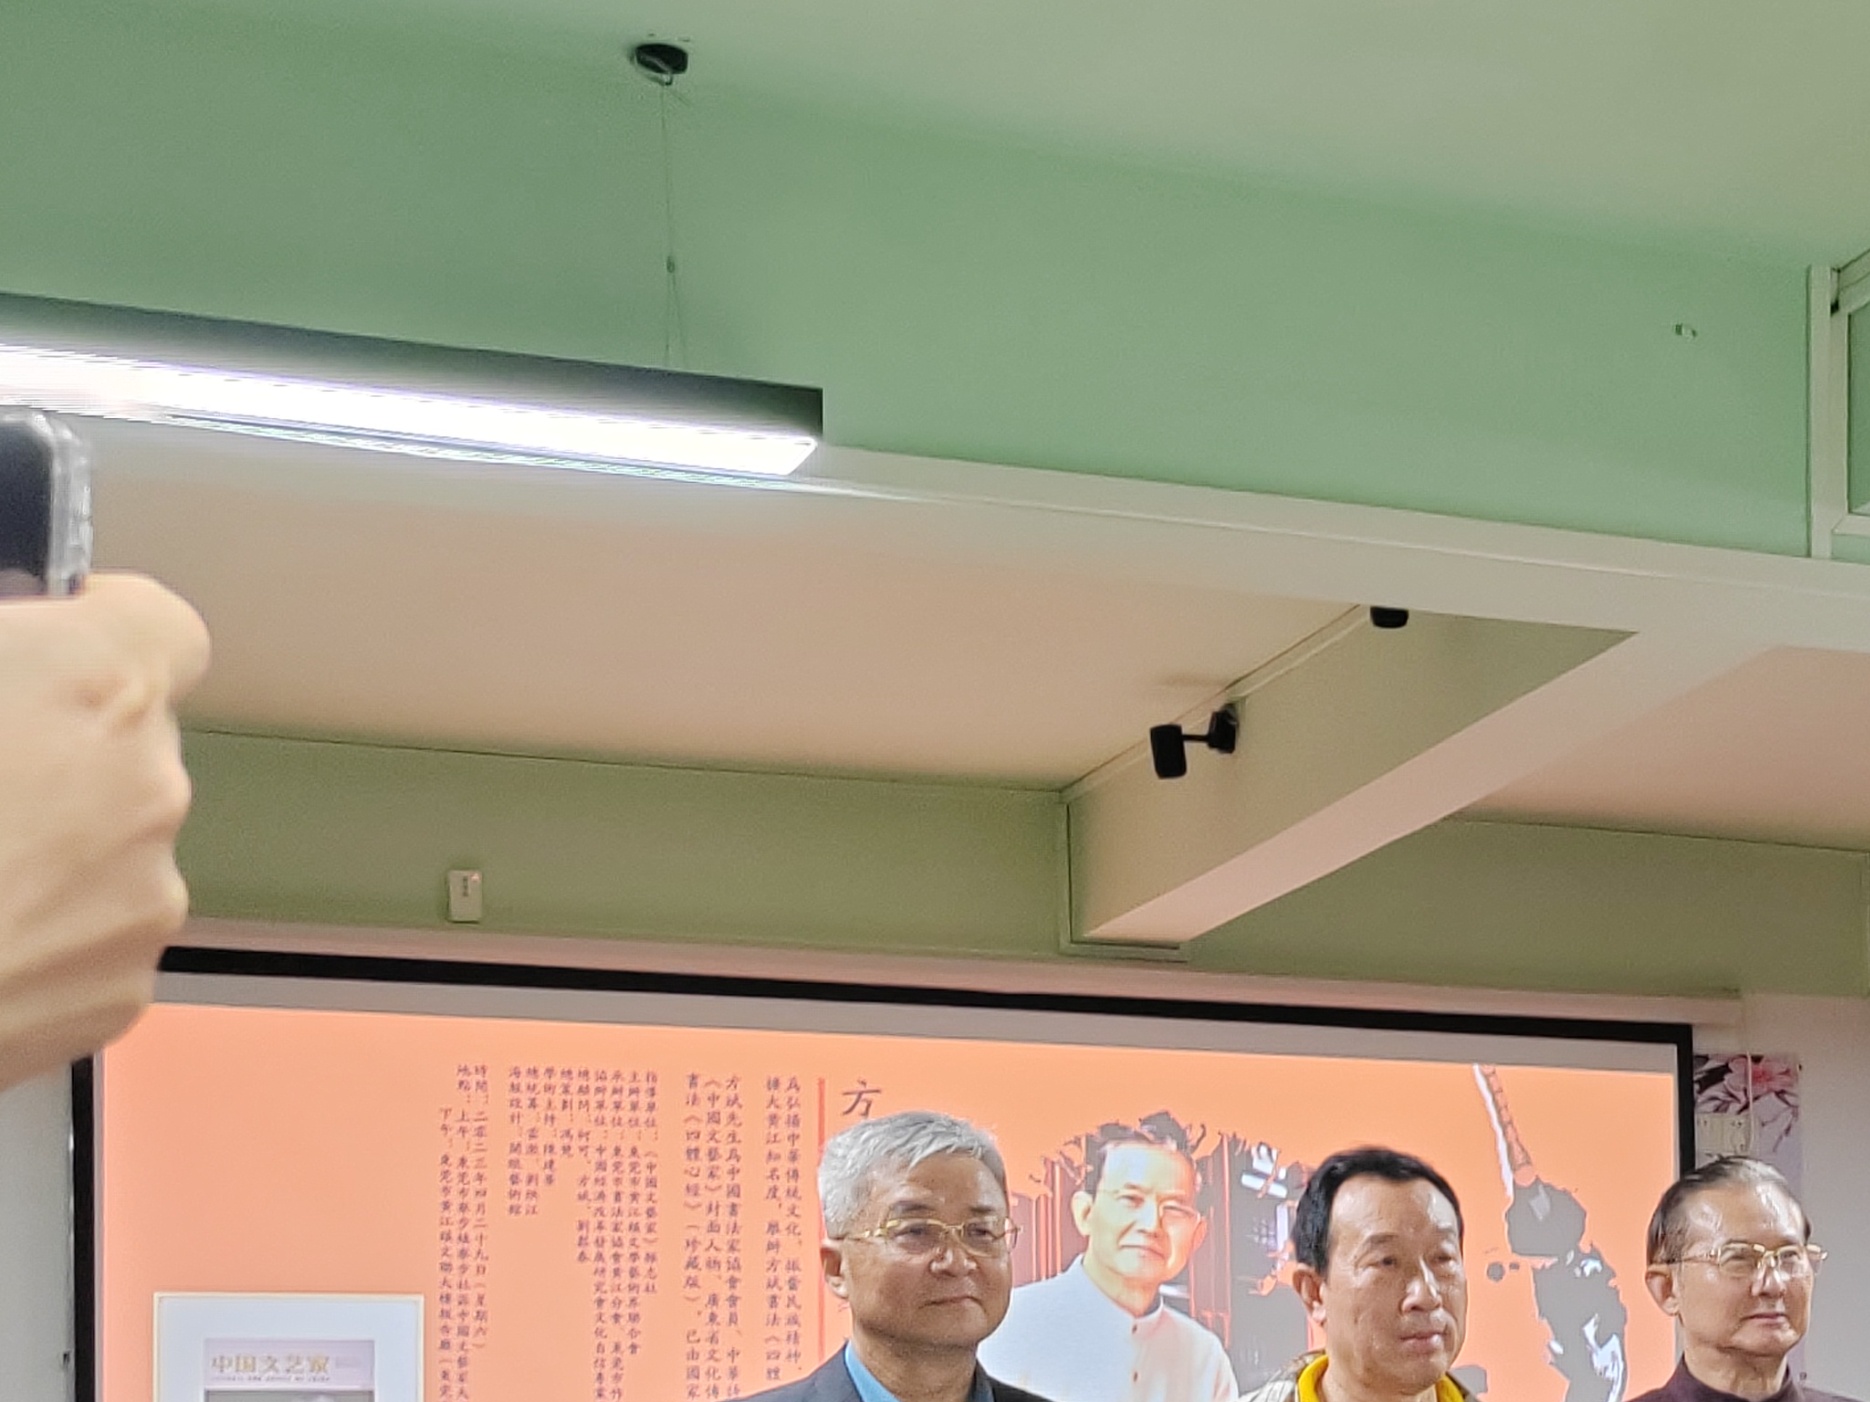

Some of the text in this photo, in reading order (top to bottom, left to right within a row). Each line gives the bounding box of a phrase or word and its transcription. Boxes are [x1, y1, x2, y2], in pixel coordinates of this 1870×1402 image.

[211, 1354, 330, 1374] 中国文艺家
